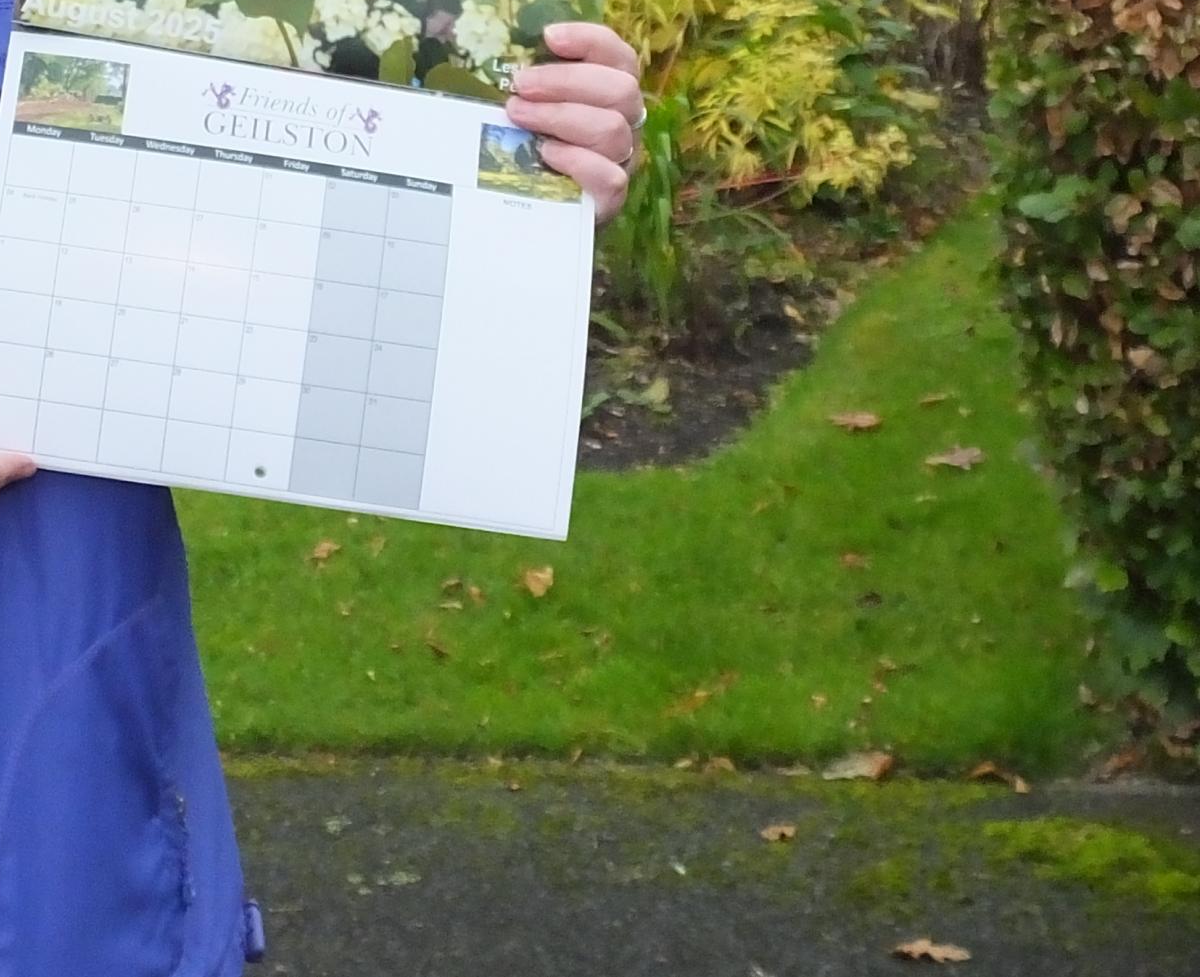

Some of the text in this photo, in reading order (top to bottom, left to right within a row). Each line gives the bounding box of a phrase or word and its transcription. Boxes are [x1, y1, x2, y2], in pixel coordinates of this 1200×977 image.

[145, 8, 224, 43] 2025
[239, 87, 351, 126] Friends of
[203, 110, 373, 157] GEILSTON
[26, 124, 438, 192] Monday Tuesday Wednesday Thursday Friday Saturday Sunday
